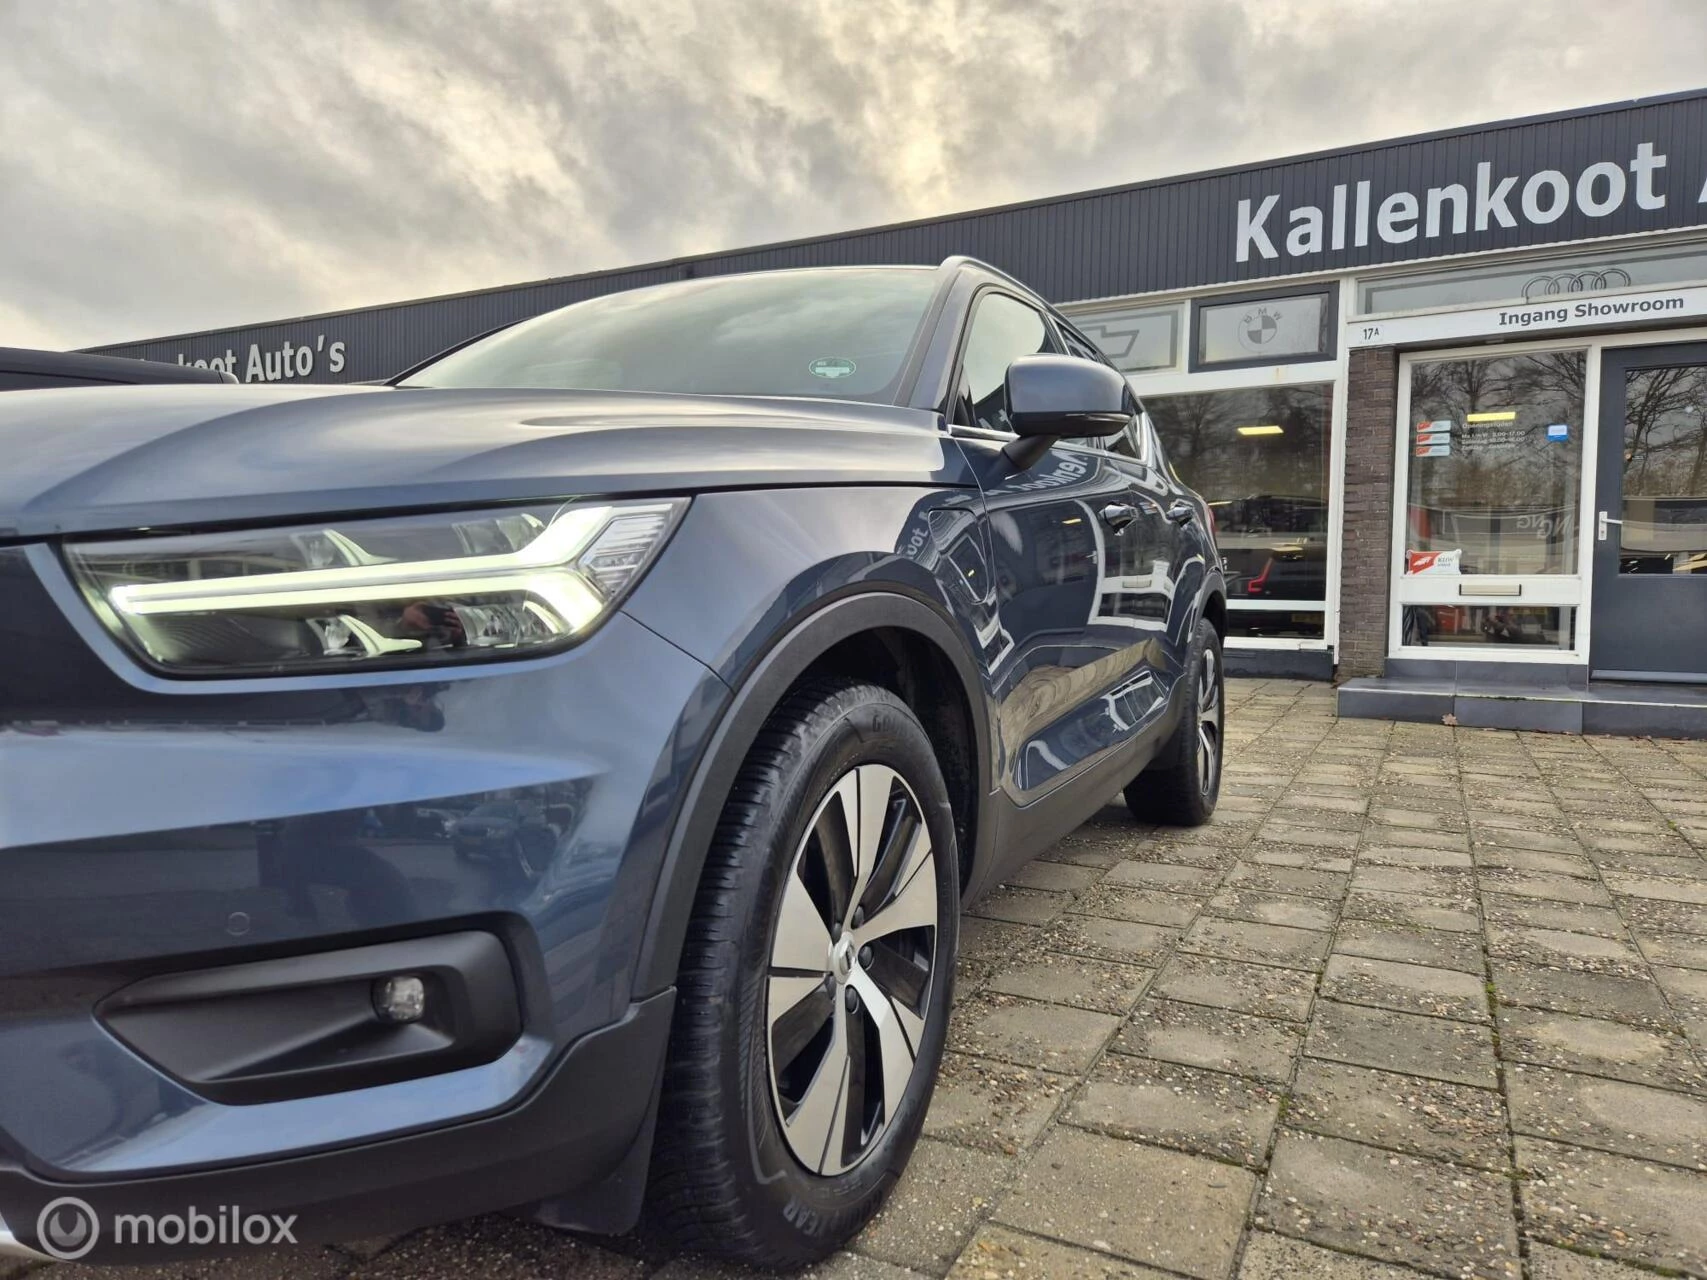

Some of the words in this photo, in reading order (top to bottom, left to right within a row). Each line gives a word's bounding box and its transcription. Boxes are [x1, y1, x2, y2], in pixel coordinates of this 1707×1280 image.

[1236, 142, 1667, 263] Kallenkoot
[1499, 309, 1568, 326] Ingang
[1574, 297, 1684, 318] Showroom
[245, 334, 345, 383] Auto's
